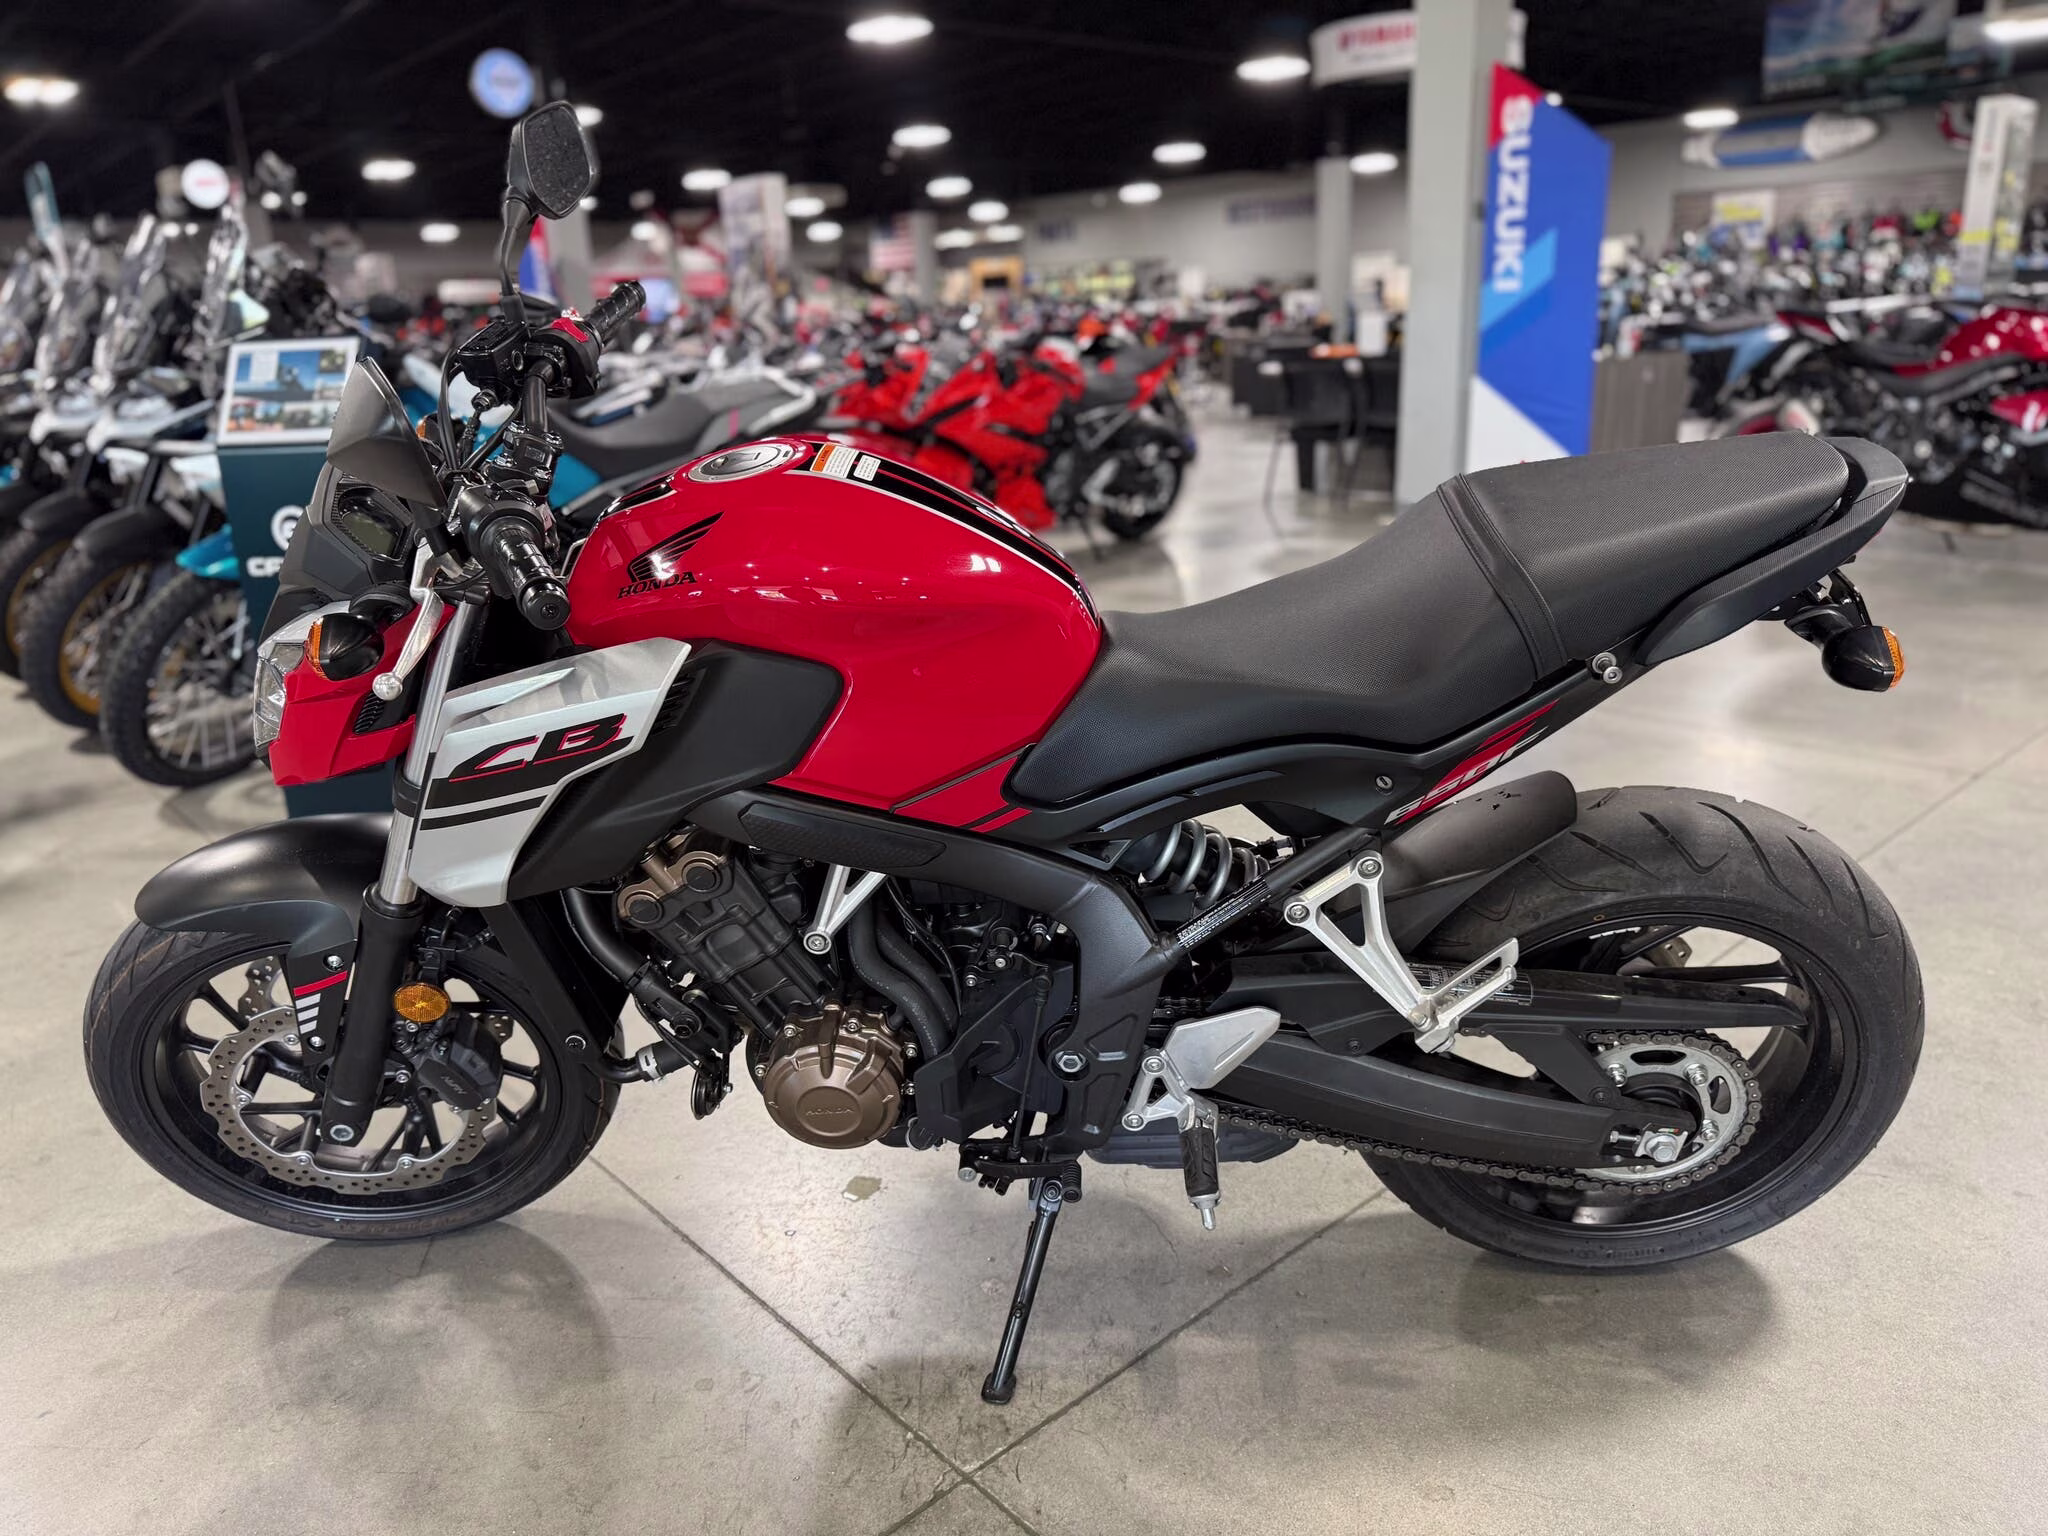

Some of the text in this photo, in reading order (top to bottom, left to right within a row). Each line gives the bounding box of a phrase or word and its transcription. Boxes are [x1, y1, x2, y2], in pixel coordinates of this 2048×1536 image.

[1493, 96, 1534, 292] SUZUKI
[617, 571, 697, 599] HONDA
[449, 712, 628, 782] CB
[1383, 725, 1549, 826] 650F
